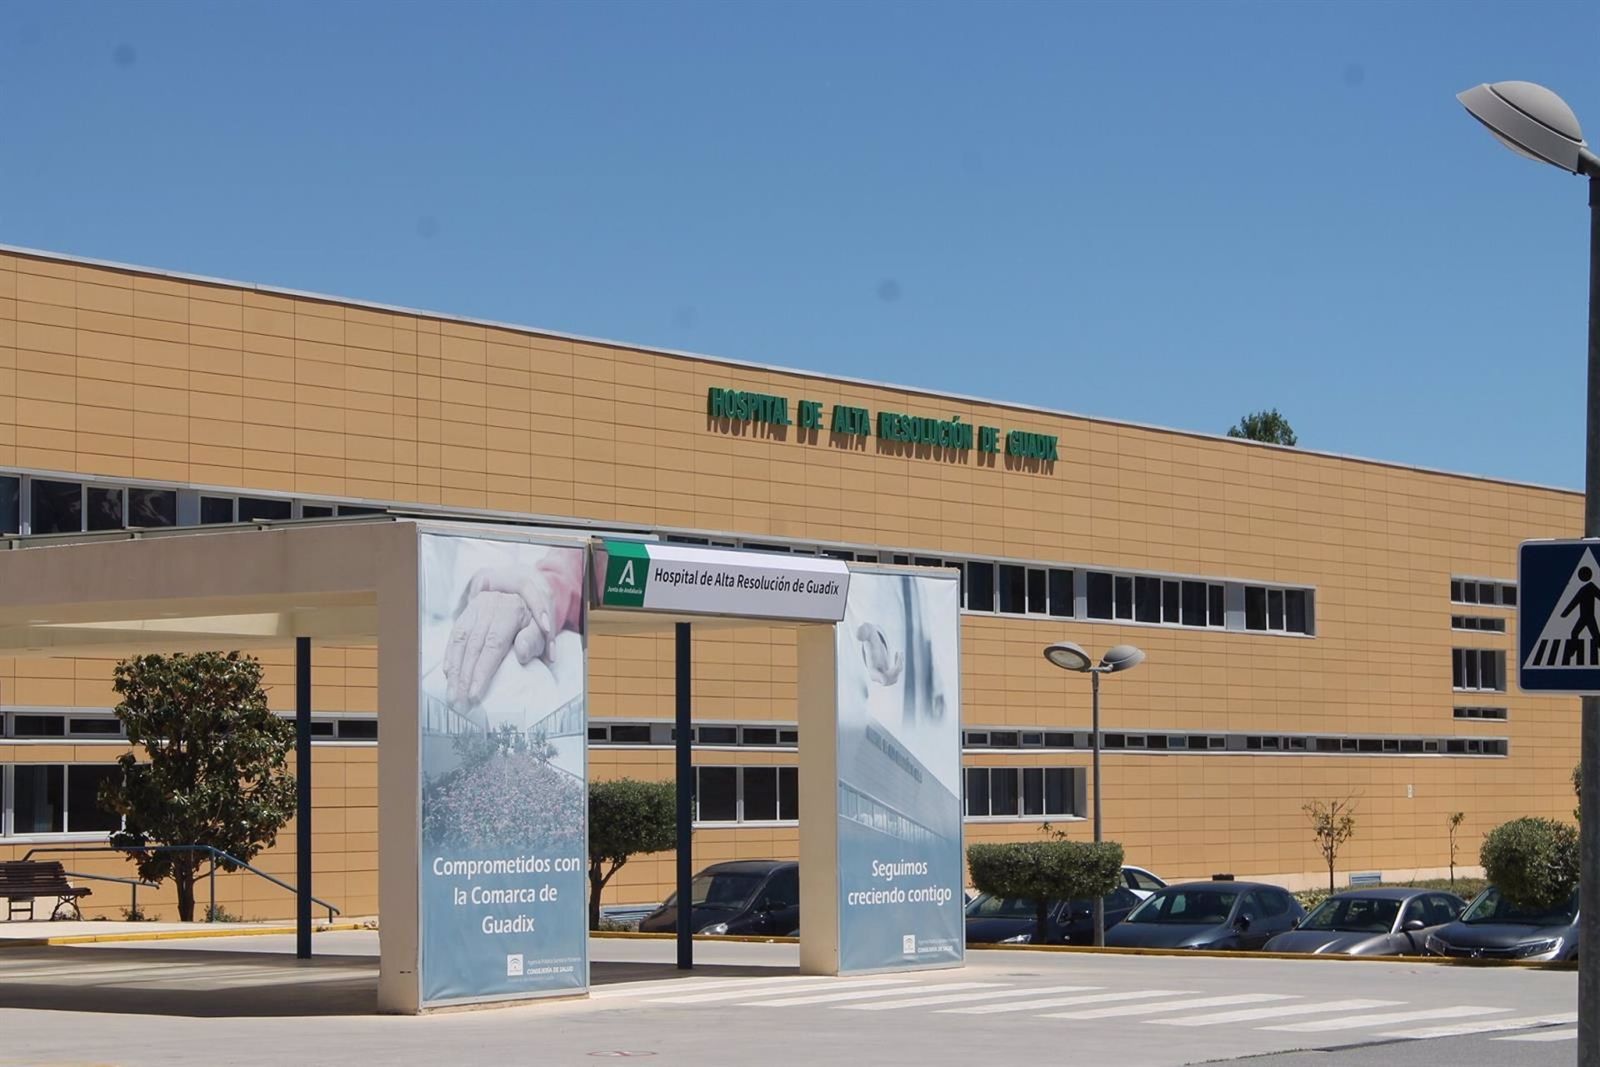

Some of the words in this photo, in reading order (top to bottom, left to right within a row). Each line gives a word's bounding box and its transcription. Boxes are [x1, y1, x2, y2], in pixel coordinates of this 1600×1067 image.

[707, 387, 792, 425] HOSPITAL
[797, 400, 824, 430] DE
[831, 405, 871, 437] ALTA
[877, 412, 974, 451] RESOLUCIÓN
[977, 426, 1001, 454] DE
[1005, 429, 1059, 461] GUADIX
[654, 567, 698, 586] Hospital
[700, 570, 713, 586] de
[715, 573, 735, 588] Alta
[737, 574, 790, 592] Resolución
[792, 577, 805, 593] de
[806, 580, 840, 596] Guadix
[433, 855, 551, 879] Comprometidos
[554, 857, 580, 872] con
[872, 858, 928, 881] Seguimos
[454, 887, 467, 905] la
[471, 886, 536, 905] Comarca
[539, 883, 558, 902] de
[848, 887, 906, 906] creciendo
[908, 884, 952, 906] contigo
[481, 914, 535, 934] Guadix
